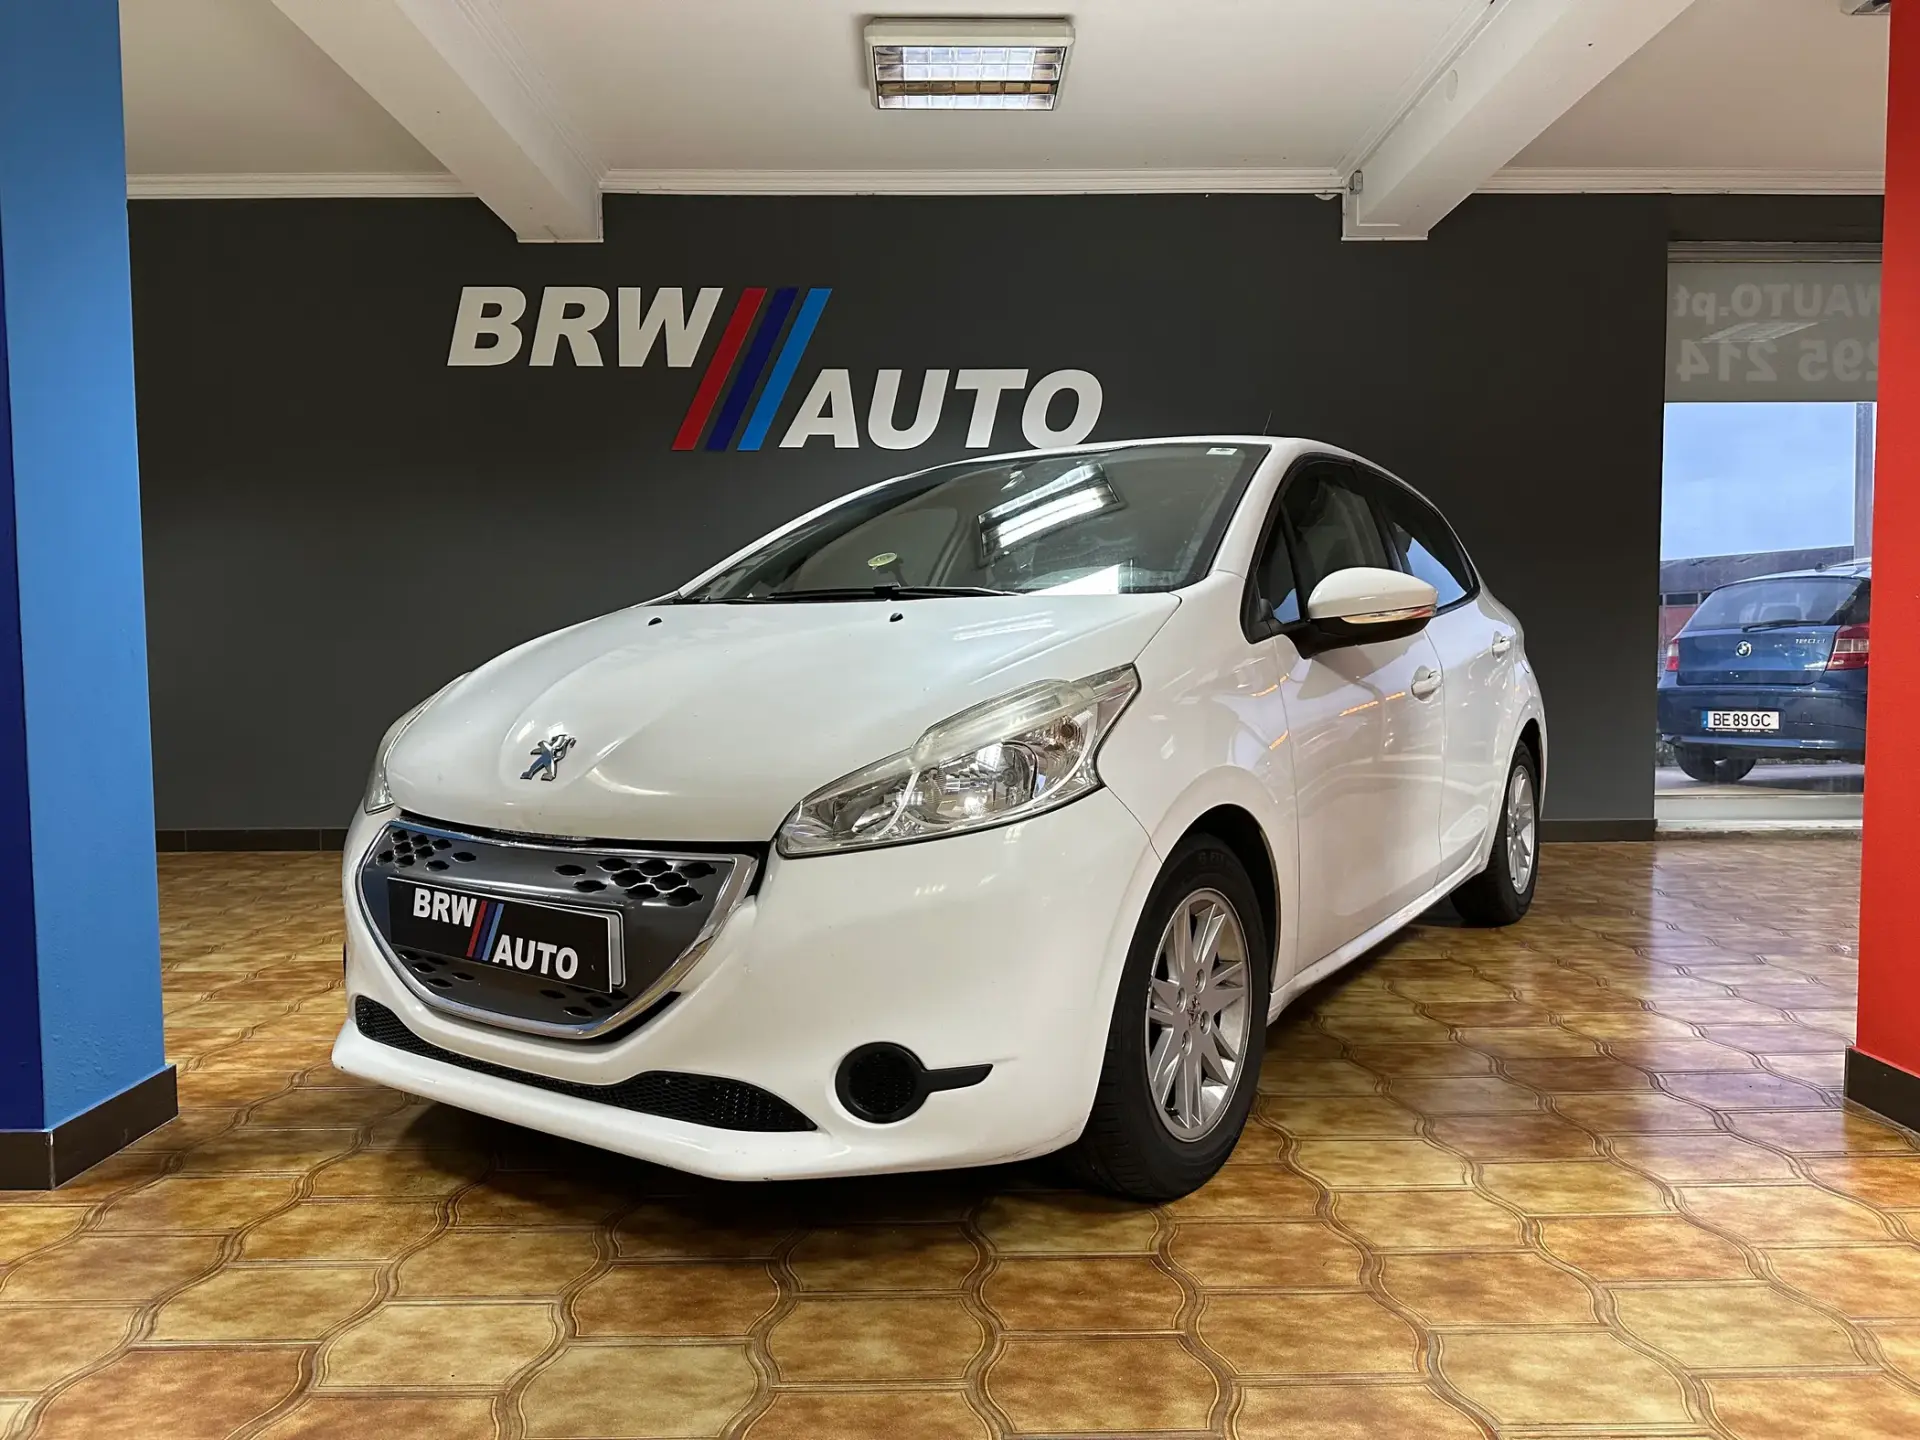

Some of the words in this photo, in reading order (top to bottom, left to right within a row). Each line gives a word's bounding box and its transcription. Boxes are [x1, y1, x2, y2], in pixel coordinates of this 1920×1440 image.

[447, 286, 724, 367] BRW
[779, 369, 1103, 449] AUTO
[413, 887, 477, 928] BRW
[492, 934, 579, 980] AUTO
